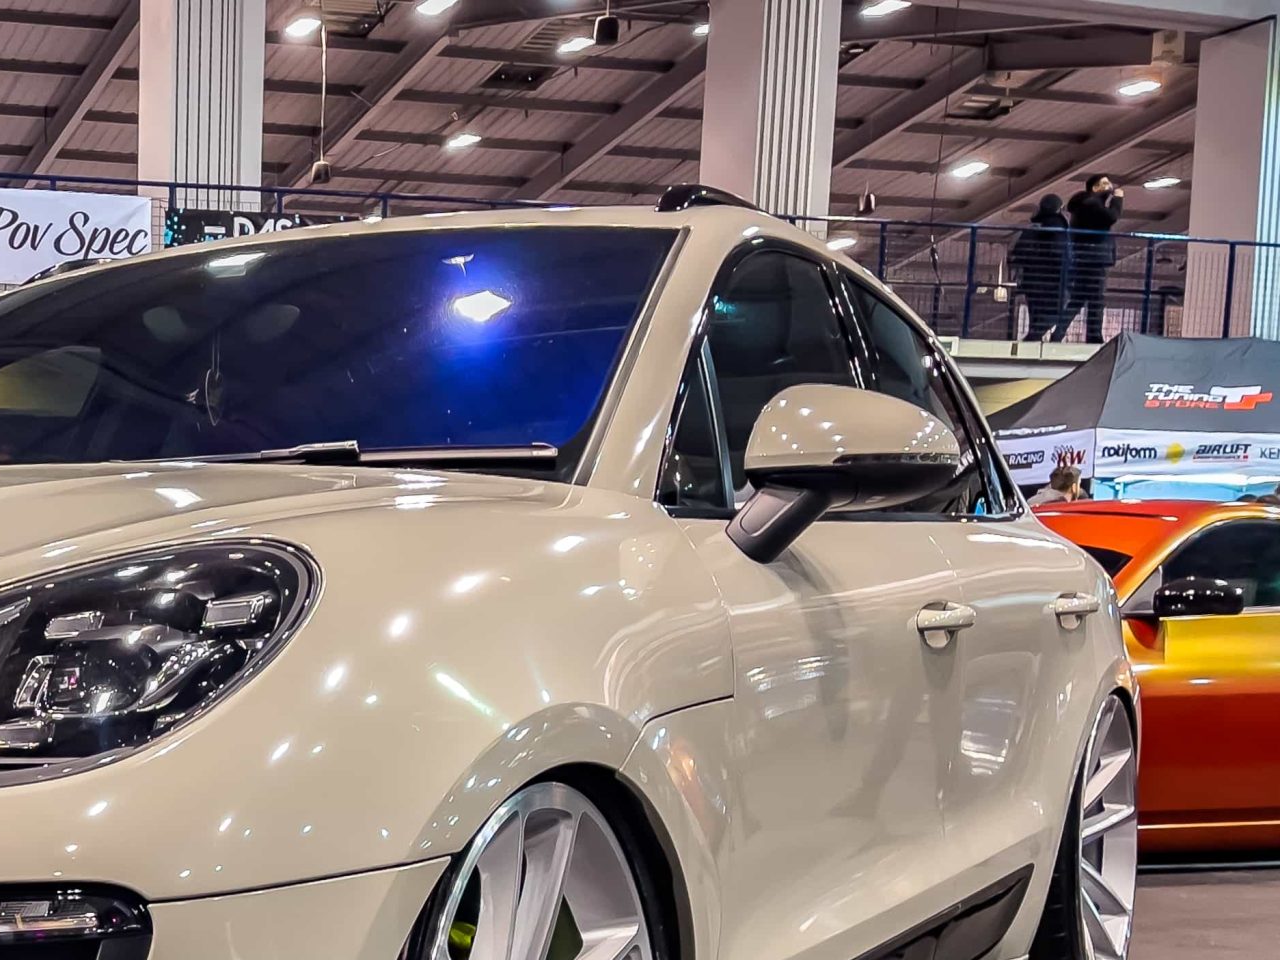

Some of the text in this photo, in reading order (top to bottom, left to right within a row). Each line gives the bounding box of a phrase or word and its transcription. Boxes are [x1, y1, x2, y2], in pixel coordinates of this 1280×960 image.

[53, 210, 151, 259] Spec
[1149, 383, 1194, 393] THE
[1009, 452, 1044, 465] RACING
[1102, 444, 1157, 463] rotiform
[1259, 448, 1280, 460] KE
